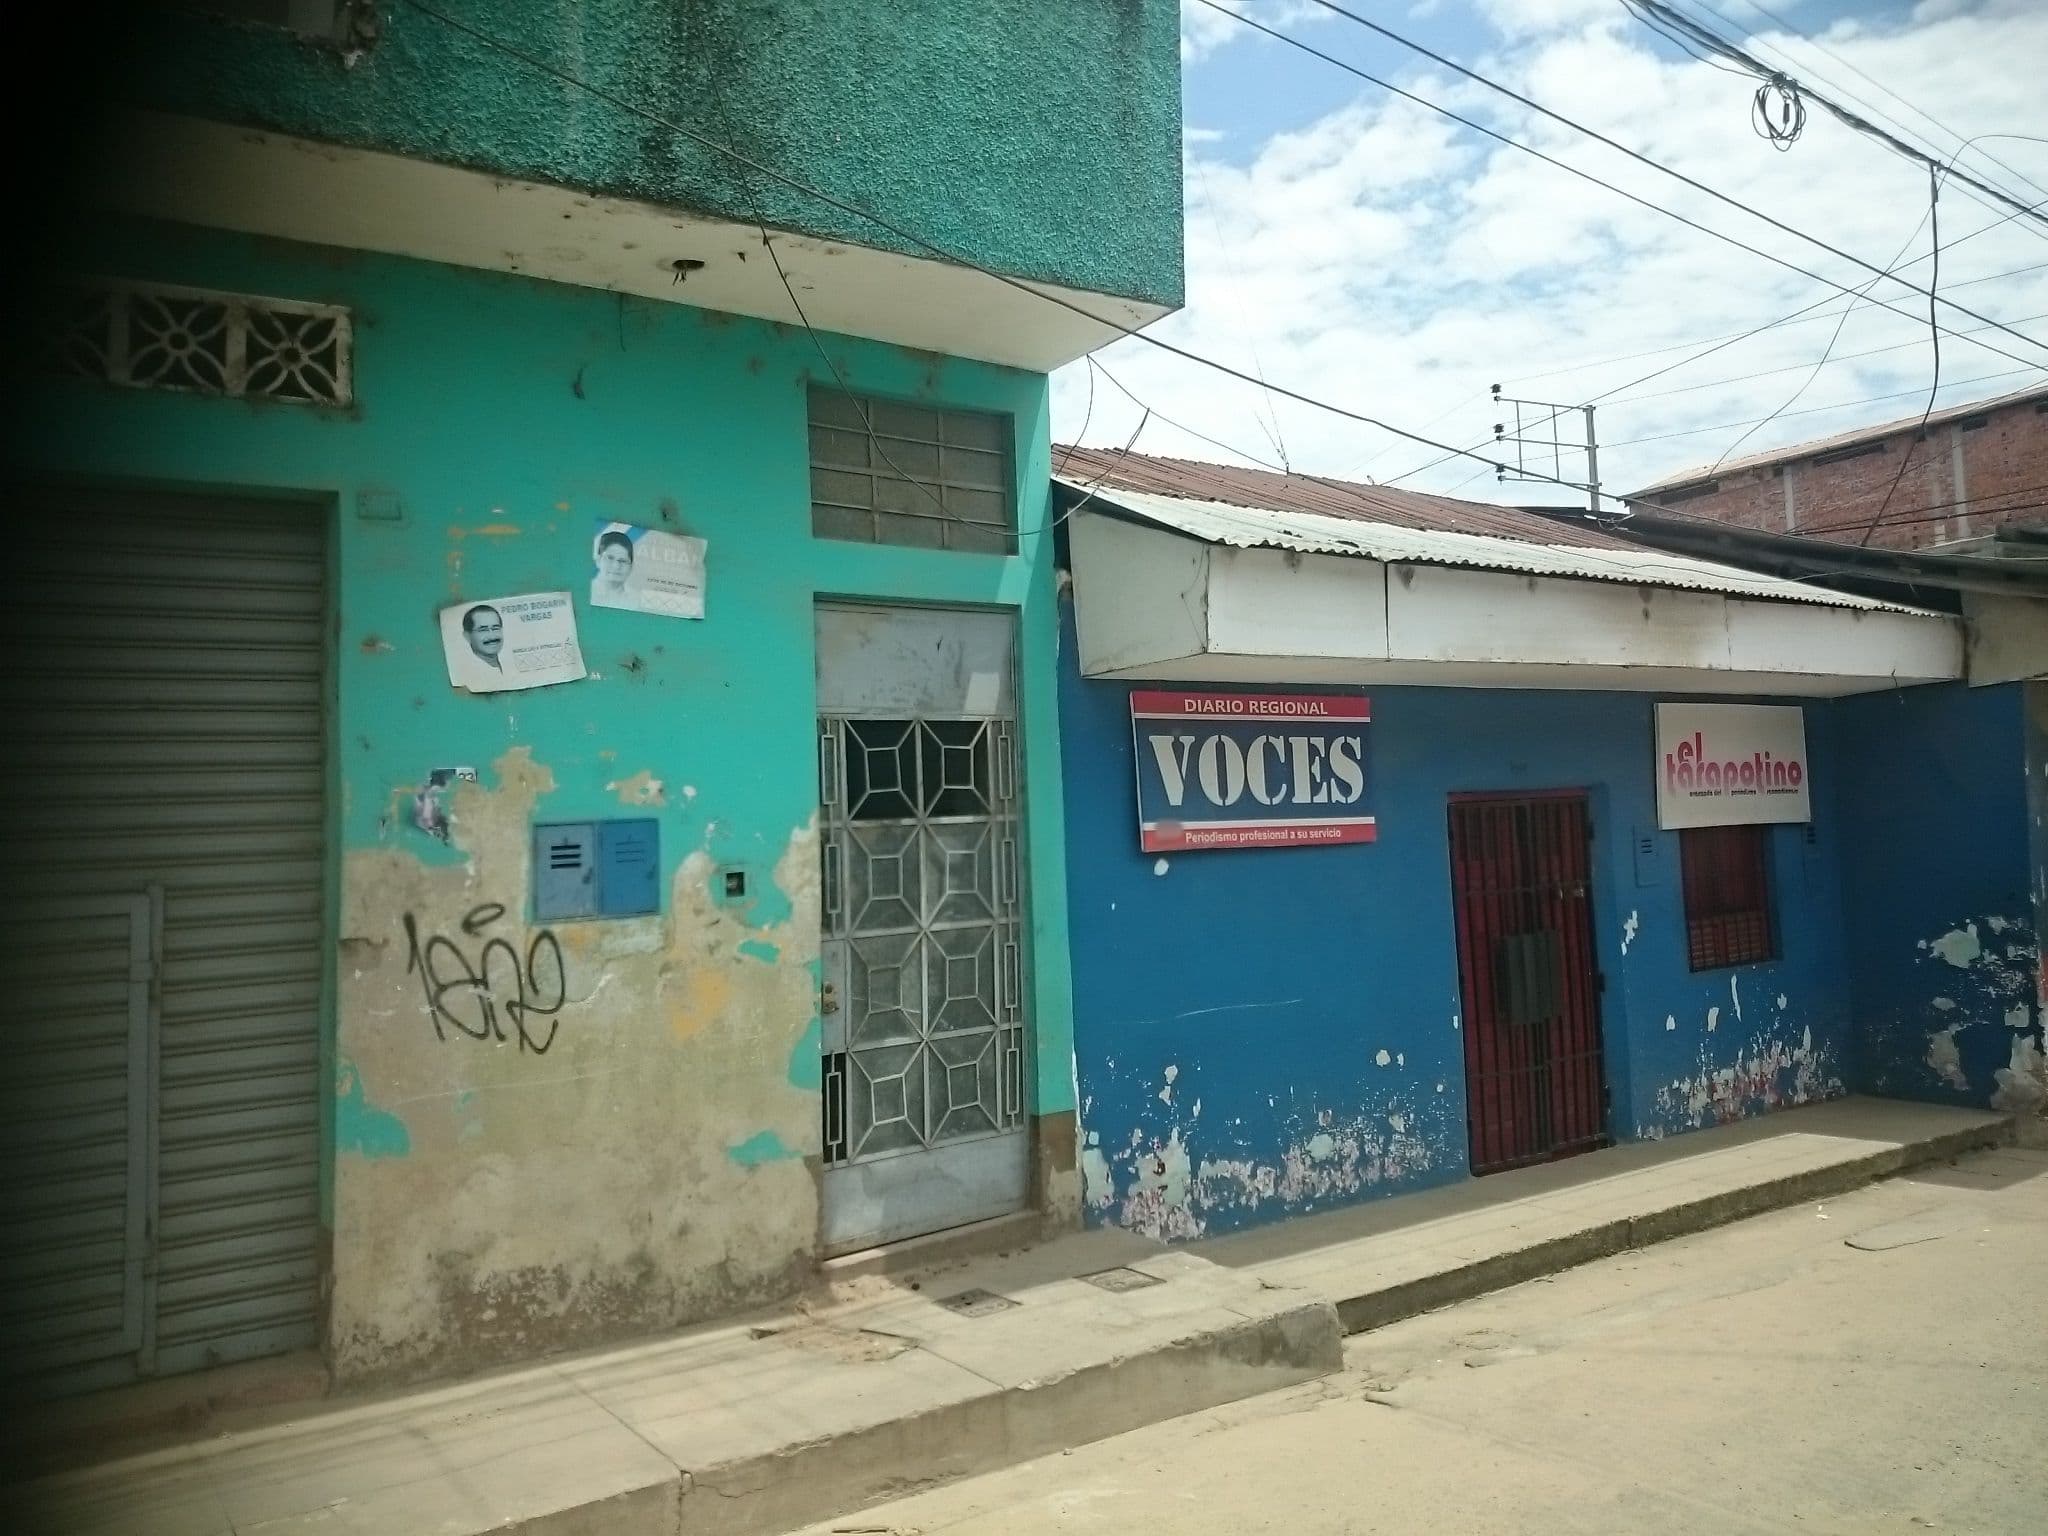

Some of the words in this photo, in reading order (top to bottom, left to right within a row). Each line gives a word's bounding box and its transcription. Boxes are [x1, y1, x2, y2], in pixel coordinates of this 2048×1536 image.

[500, 602, 529, 614] PEDRO
[520, 611, 552, 622] VARGAS
[1184, 698, 1244, 713] DIARIO
[1248, 700, 1329, 715] REGIONAL
[1677, 731, 1703, 763] el
[1148, 734, 1364, 807] VOCES
[1665, 750, 1802, 793] tarapotino
[1185, 831, 1238, 844] Periodismo
[1239, 829, 1288, 843] profesional
[1297, 831, 1308, 839] su
[1309, 828, 1341, 839] servicio
